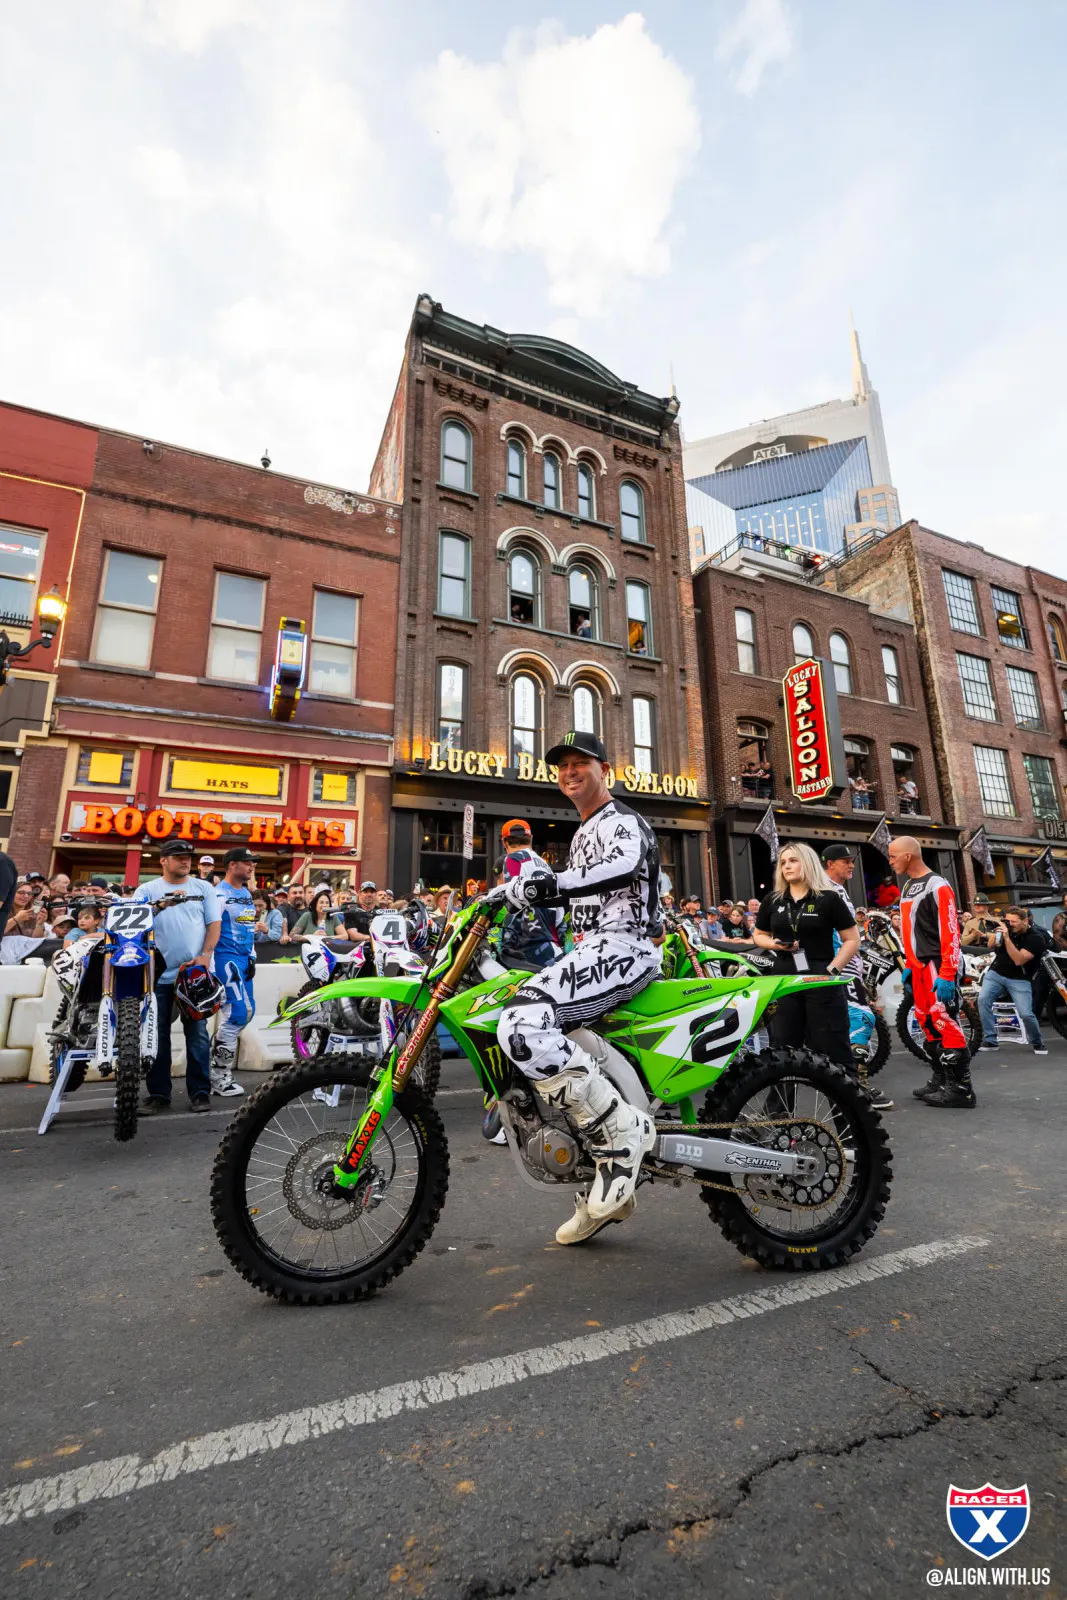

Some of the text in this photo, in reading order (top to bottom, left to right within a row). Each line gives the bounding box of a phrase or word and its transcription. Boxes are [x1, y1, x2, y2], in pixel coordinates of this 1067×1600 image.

[755, 445, 785, 460] AT&T
[787, 665, 817, 688] LUCKY
[794, 680, 820, 782] SALOON
[429, 741, 507, 777] LUCKY
[518, 752, 615, 788] BASD
[624, 765, 699, 798] SALOON
[206, 778, 249, 790] HATS
[797, 776, 831, 794] BASTARD
[80, 805, 346, 847] BOOTS HATS
[111, 907, 150, 931] 22
[382, 921, 401, 940] 4
[746, 954, 774, 968] TRIUMPH
[867, 955, 890, 969] TRIUMPH
[682, 984, 712, 996] Kawasaki
[147, 1007, 155, 1050] DUNLOP
[408, 1008, 434, 1056] SHOWA
[689, 1008, 742, 1064] 2
[348, 1110, 381, 1168] MAXXIS
[676, 1143, 703, 1157] DID
[788, 1246, 818, 1254] MAXXIS
